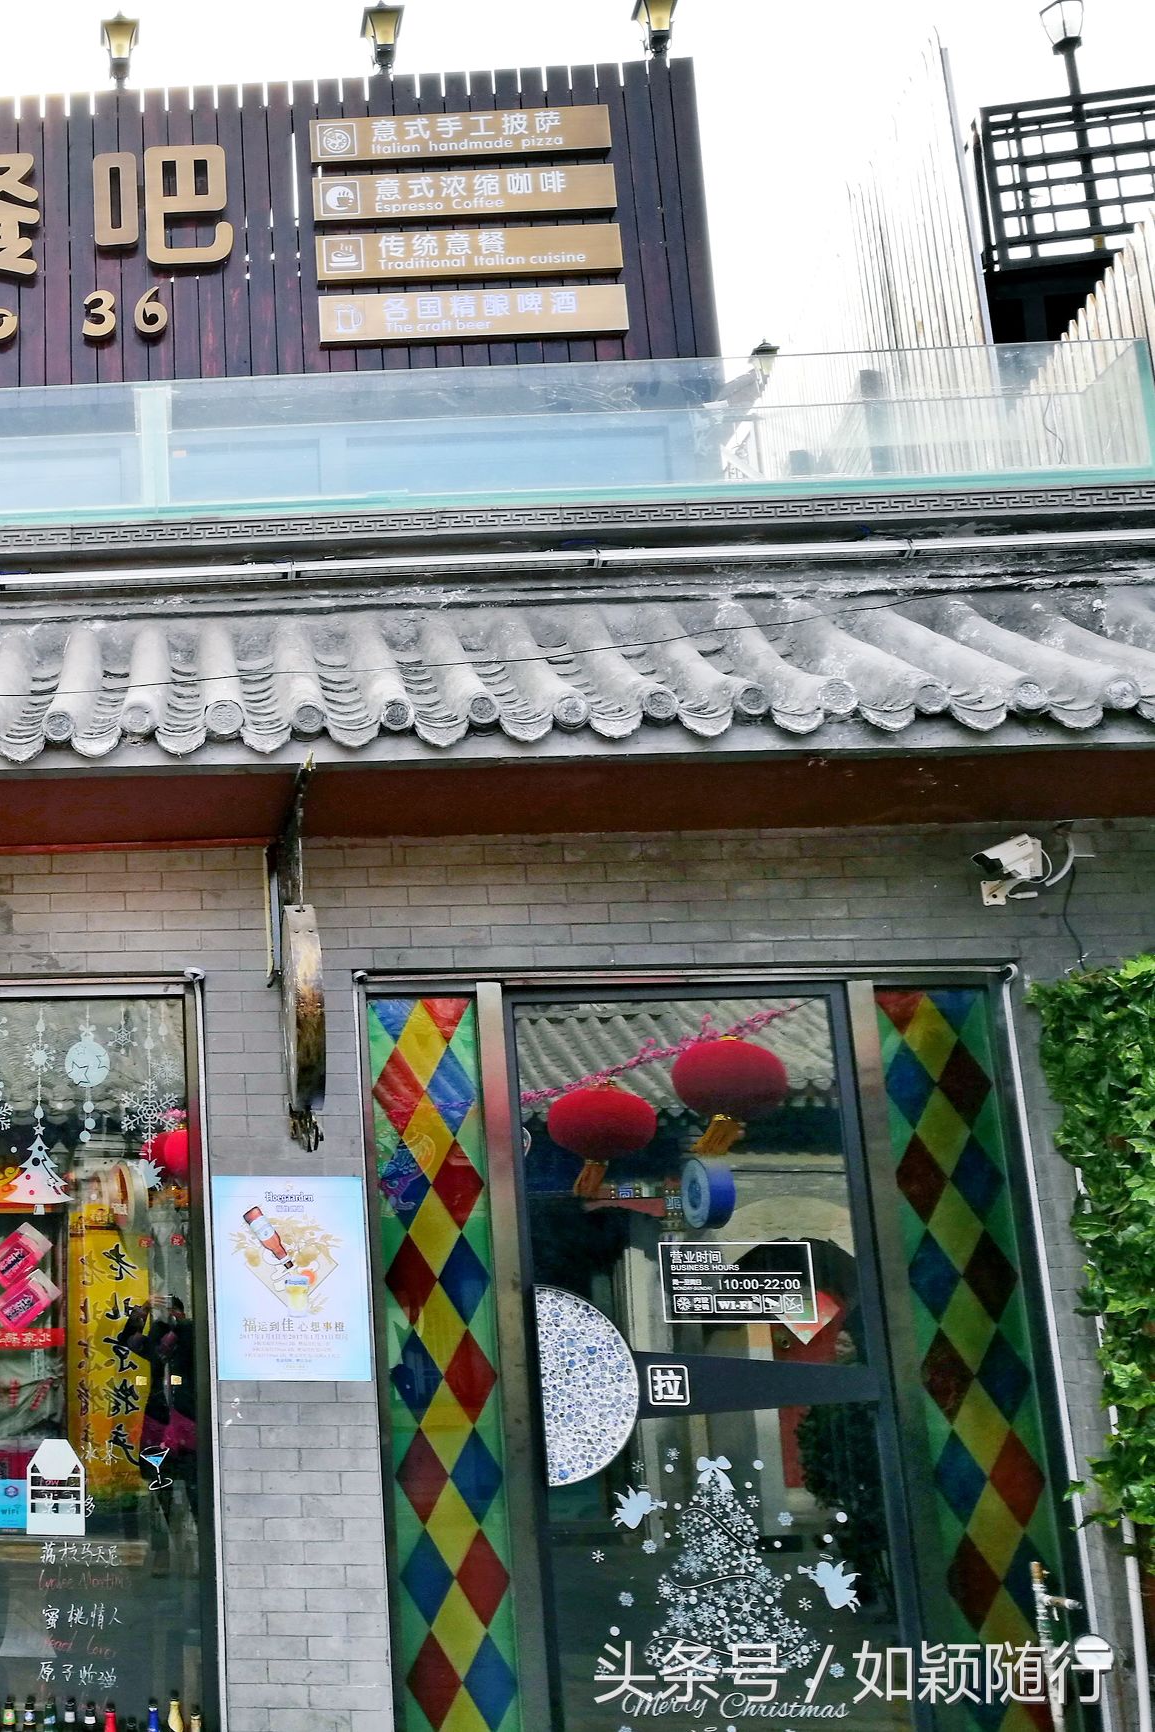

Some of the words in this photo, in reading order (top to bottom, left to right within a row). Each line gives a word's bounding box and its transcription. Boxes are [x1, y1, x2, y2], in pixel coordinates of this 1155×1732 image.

[371, 111, 561, 142] 意式手工披萨
[371, 141, 421, 155] Italian
[429, 136, 514, 152] handmade
[522, 135, 564, 151] pizza
[375, 170, 567, 201] 意式浓缩咖啡
[375, 200, 444, 214] Espresso
[452, 198, 505, 210] Coffee
[378, 232, 506, 258] 传统意餐
[379, 255, 466, 271] Traditional
[474, 254, 525, 267] Italian
[530, 252, 586, 264] cuisine
[82, 286, 170, 342] 36
[382, 291, 577, 321] 各国精酿啤酒
[385, 320, 414, 333] The
[416, 320, 450, 332] craft
[456, 317, 493, 330] beer
[264, 1191, 314, 1204] Hoegaarden
[670, 1250, 722, 1263] 营业时间
[723, 1279, 801, 1290] 10:00-22:00
[717, 1300, 753, 1310] WI-FI
[242, 1318, 295, 1332] 福运到佳
[298, 1320, 346, 1332] 心想事橙
[653, 1369, 684, 1400] 拉
[42, 1602, 124, 1631] 蜜桃情人
[719, 1690, 850, 1720] Christmas
